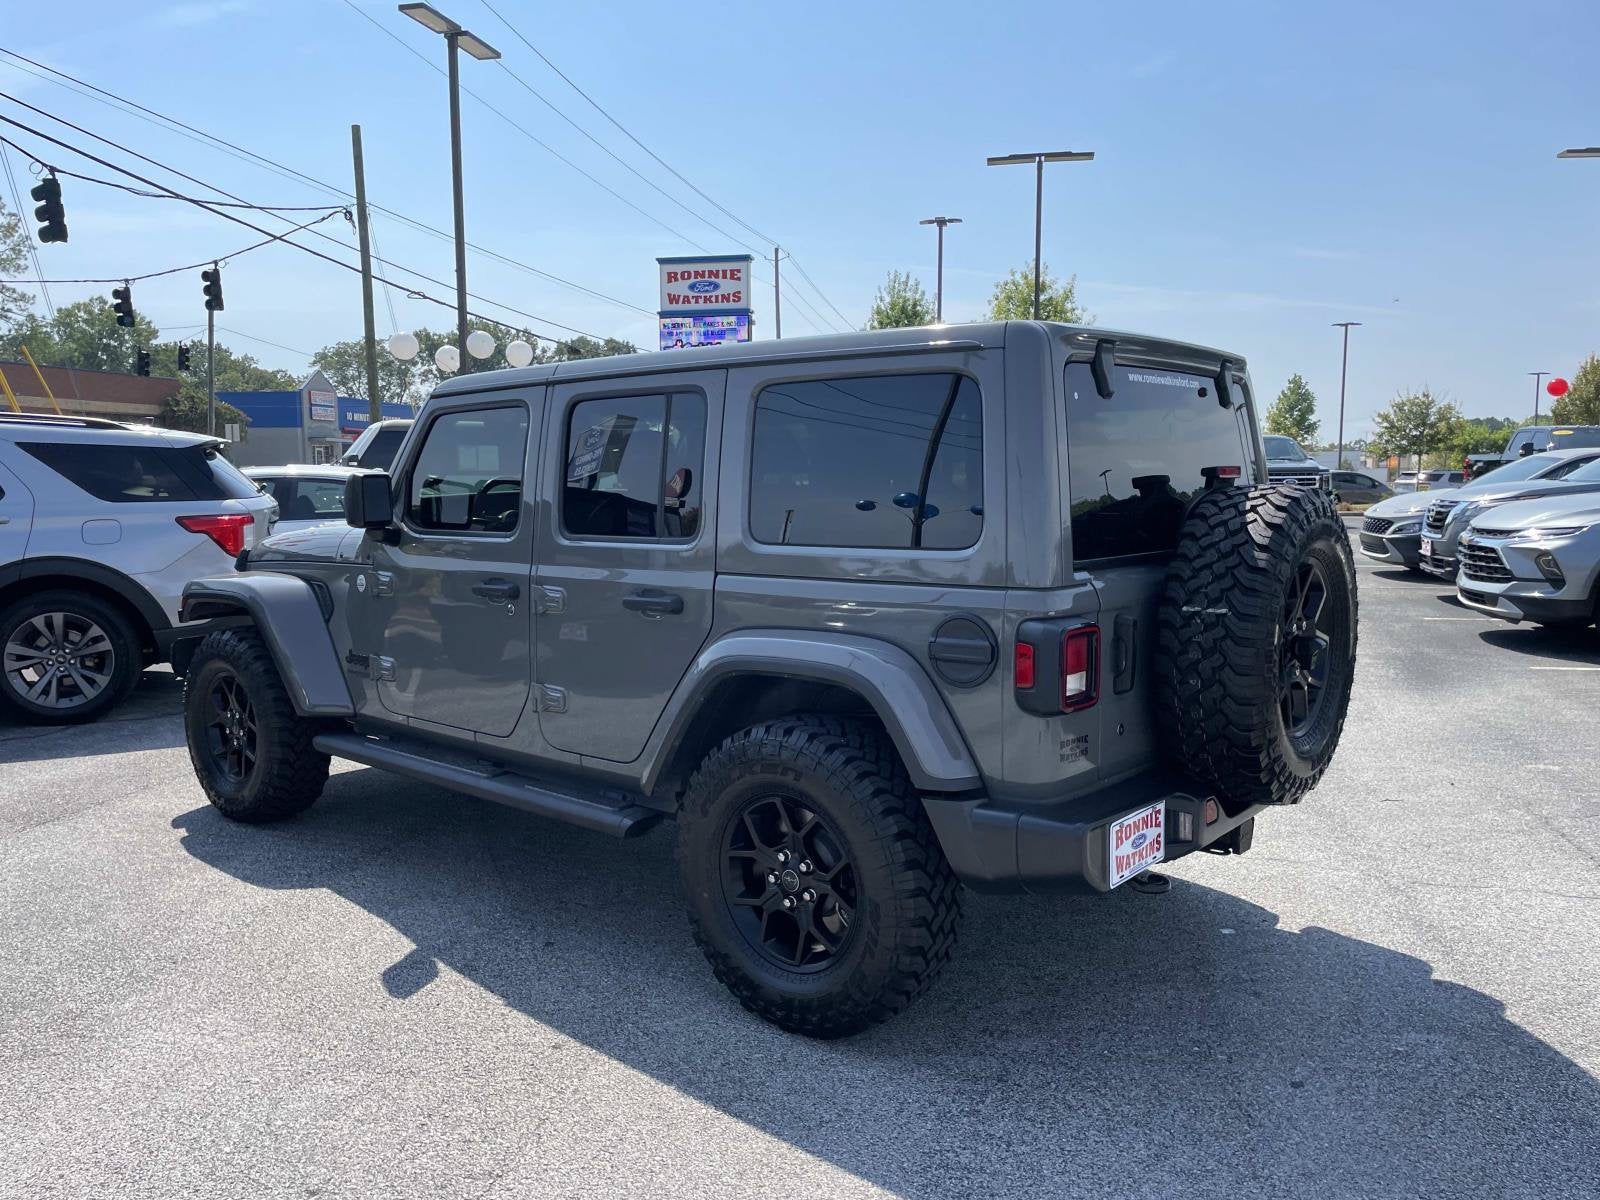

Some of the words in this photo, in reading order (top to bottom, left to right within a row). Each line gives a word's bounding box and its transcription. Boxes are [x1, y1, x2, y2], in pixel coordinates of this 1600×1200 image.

[667, 269, 742, 284] RONNIE
[667, 291, 742, 305] WATKINS
[346, 411, 353, 421] 10
[353, 412, 370, 422] MINUT
[1059, 734, 1089, 750] RONNIE
[1115, 809, 1161, 851] RONNIE
[1115, 832, 1161, 875] WATKINS
